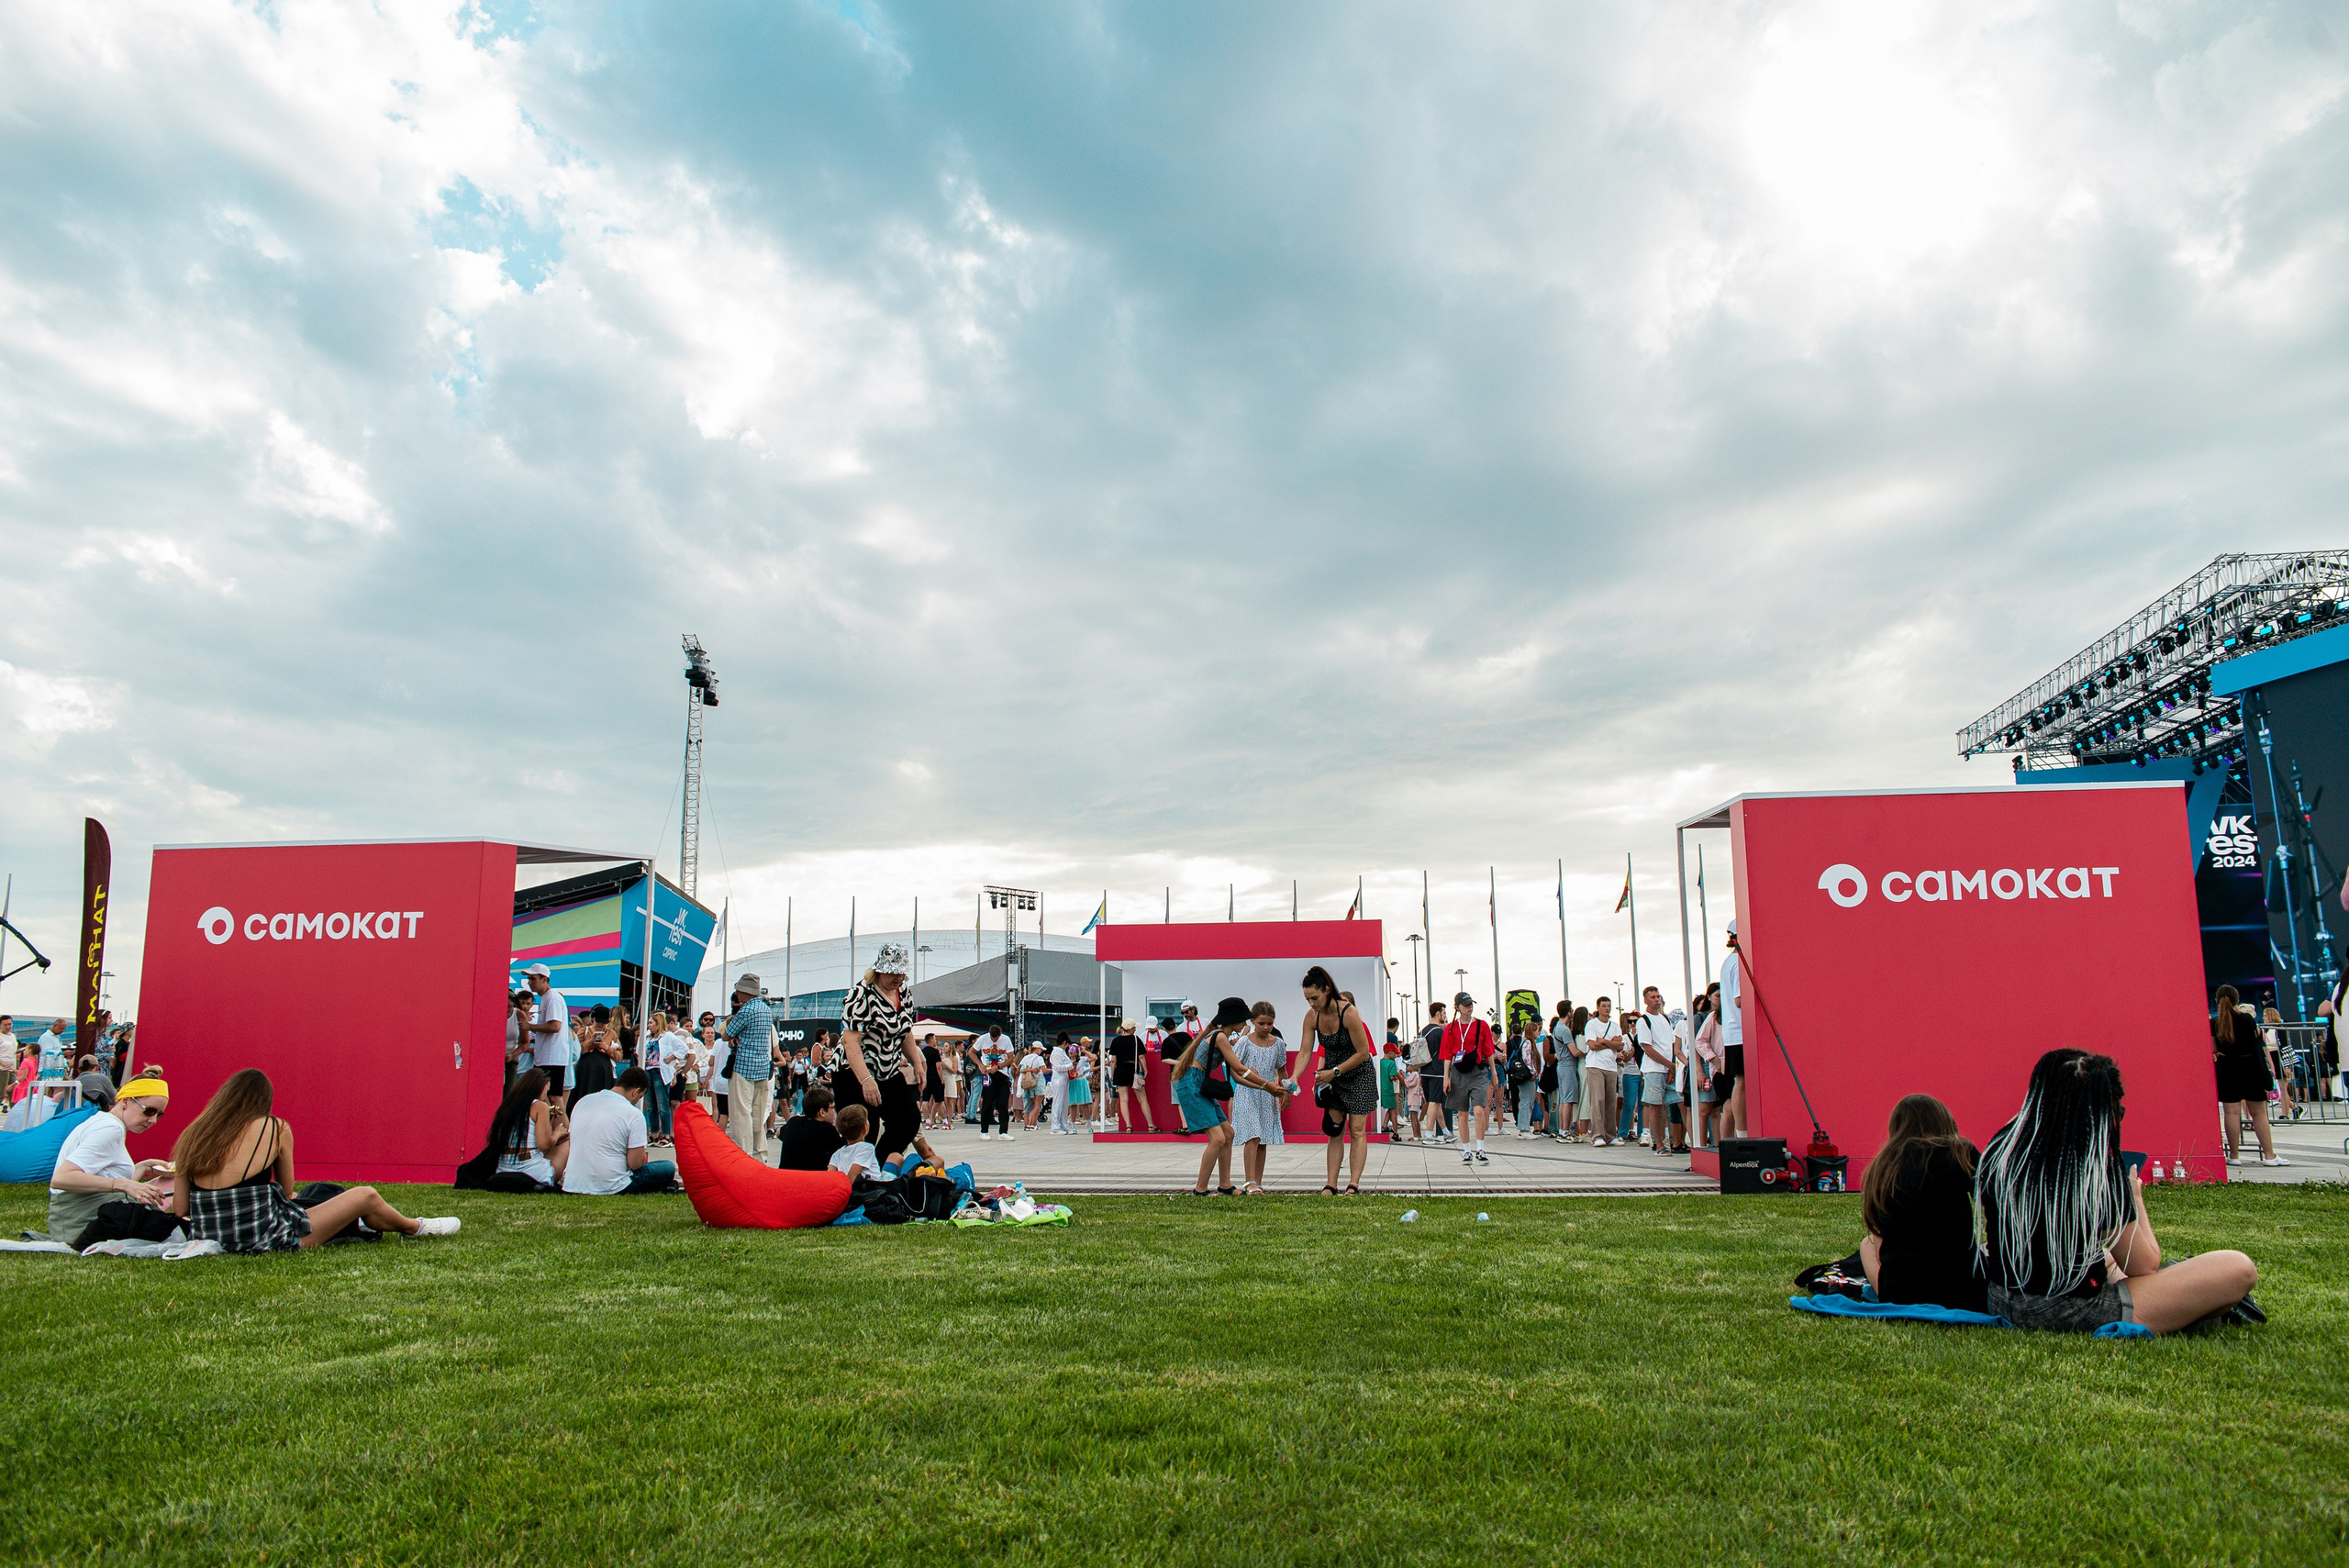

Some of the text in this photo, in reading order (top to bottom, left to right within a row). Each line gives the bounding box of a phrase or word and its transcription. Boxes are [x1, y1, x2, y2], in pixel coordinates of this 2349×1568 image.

[2210, 816, 2254, 835] VK
[2202, 834, 2258, 855] es
[2211, 855, 2257, 868] 2024
[778, 1029, 805, 1041] ОЧНО
[1024, 1029, 1051, 1044] est
[1729, 1161, 1759, 1169] Alpenbox
